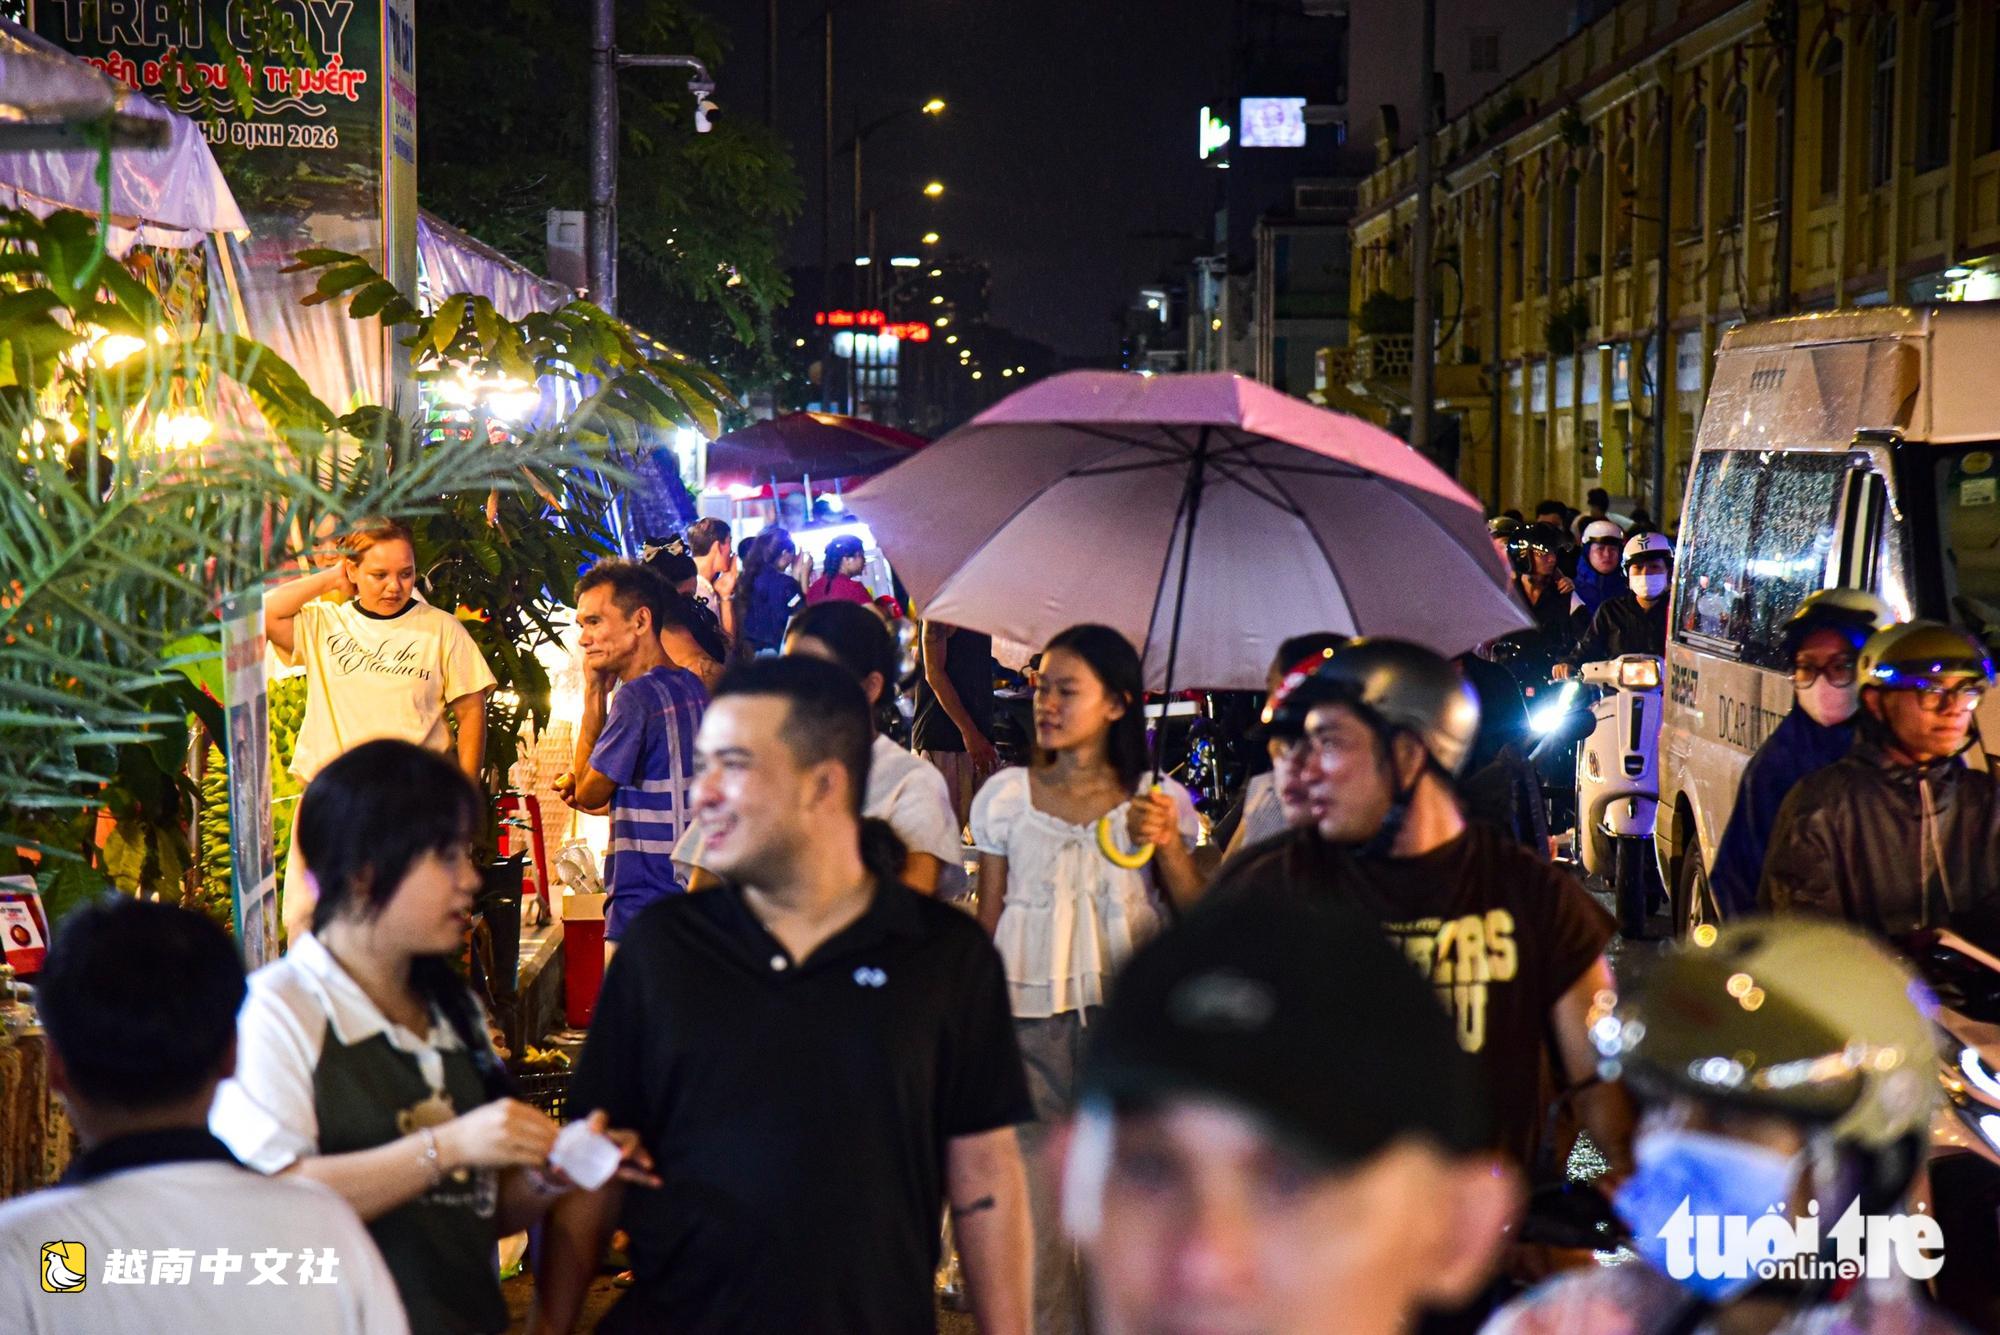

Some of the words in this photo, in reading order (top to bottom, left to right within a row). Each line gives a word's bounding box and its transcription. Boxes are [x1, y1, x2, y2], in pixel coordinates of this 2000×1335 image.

[79, 50, 141, 91] ÊN
[142, 46, 193, 94] BN
[230, 122, 284, 150] ĐỊNH
[287, 125, 339, 149] 2026
